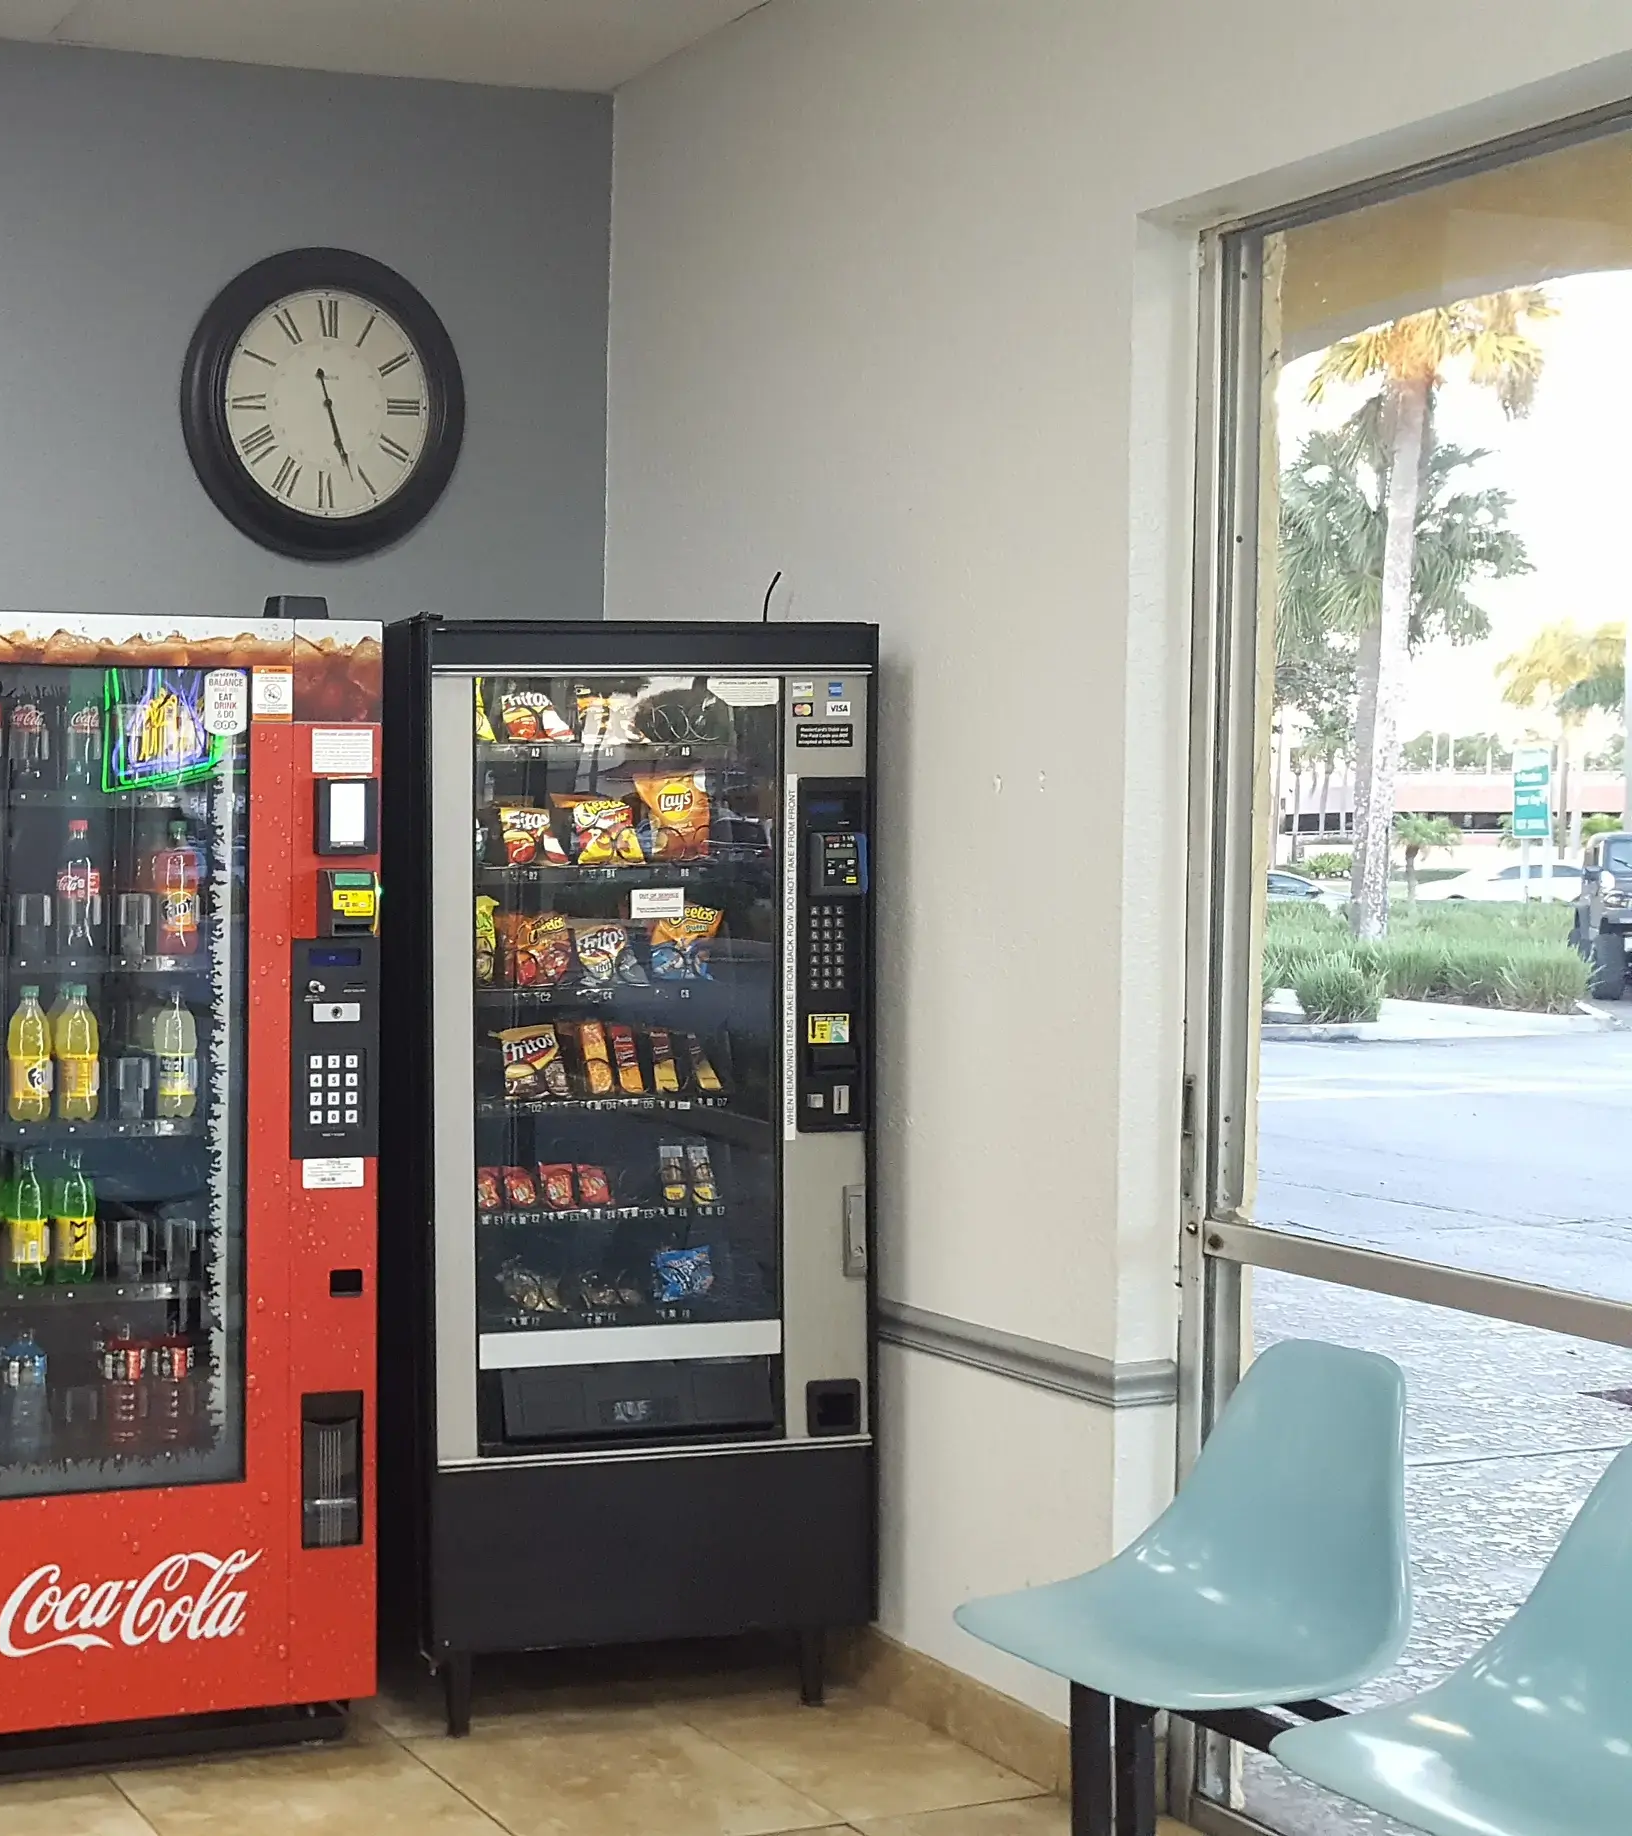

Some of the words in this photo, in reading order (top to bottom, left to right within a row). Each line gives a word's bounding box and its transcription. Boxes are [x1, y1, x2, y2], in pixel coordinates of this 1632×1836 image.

[208, 678, 244, 687] BALANCE
[214, 701, 237, 710] DRINK
[218, 692, 233, 701] EAT
[830, 704, 848, 712] VISA
[223, 710, 234, 718] DO
[788, 789, 796, 820] FRONT
[787, 896, 794, 910] DO
[786, 939, 794, 963] BACK
[786, 965, 794, 992] FROM
[786, 993, 794, 1016] TAKE
[786, 1019, 794, 1046] ITEMS
[503, 1033, 554, 1062] Fritos
[786, 1048, 794, 1097] REMOVING
[786, 1098, 794, 1126] WHEN
